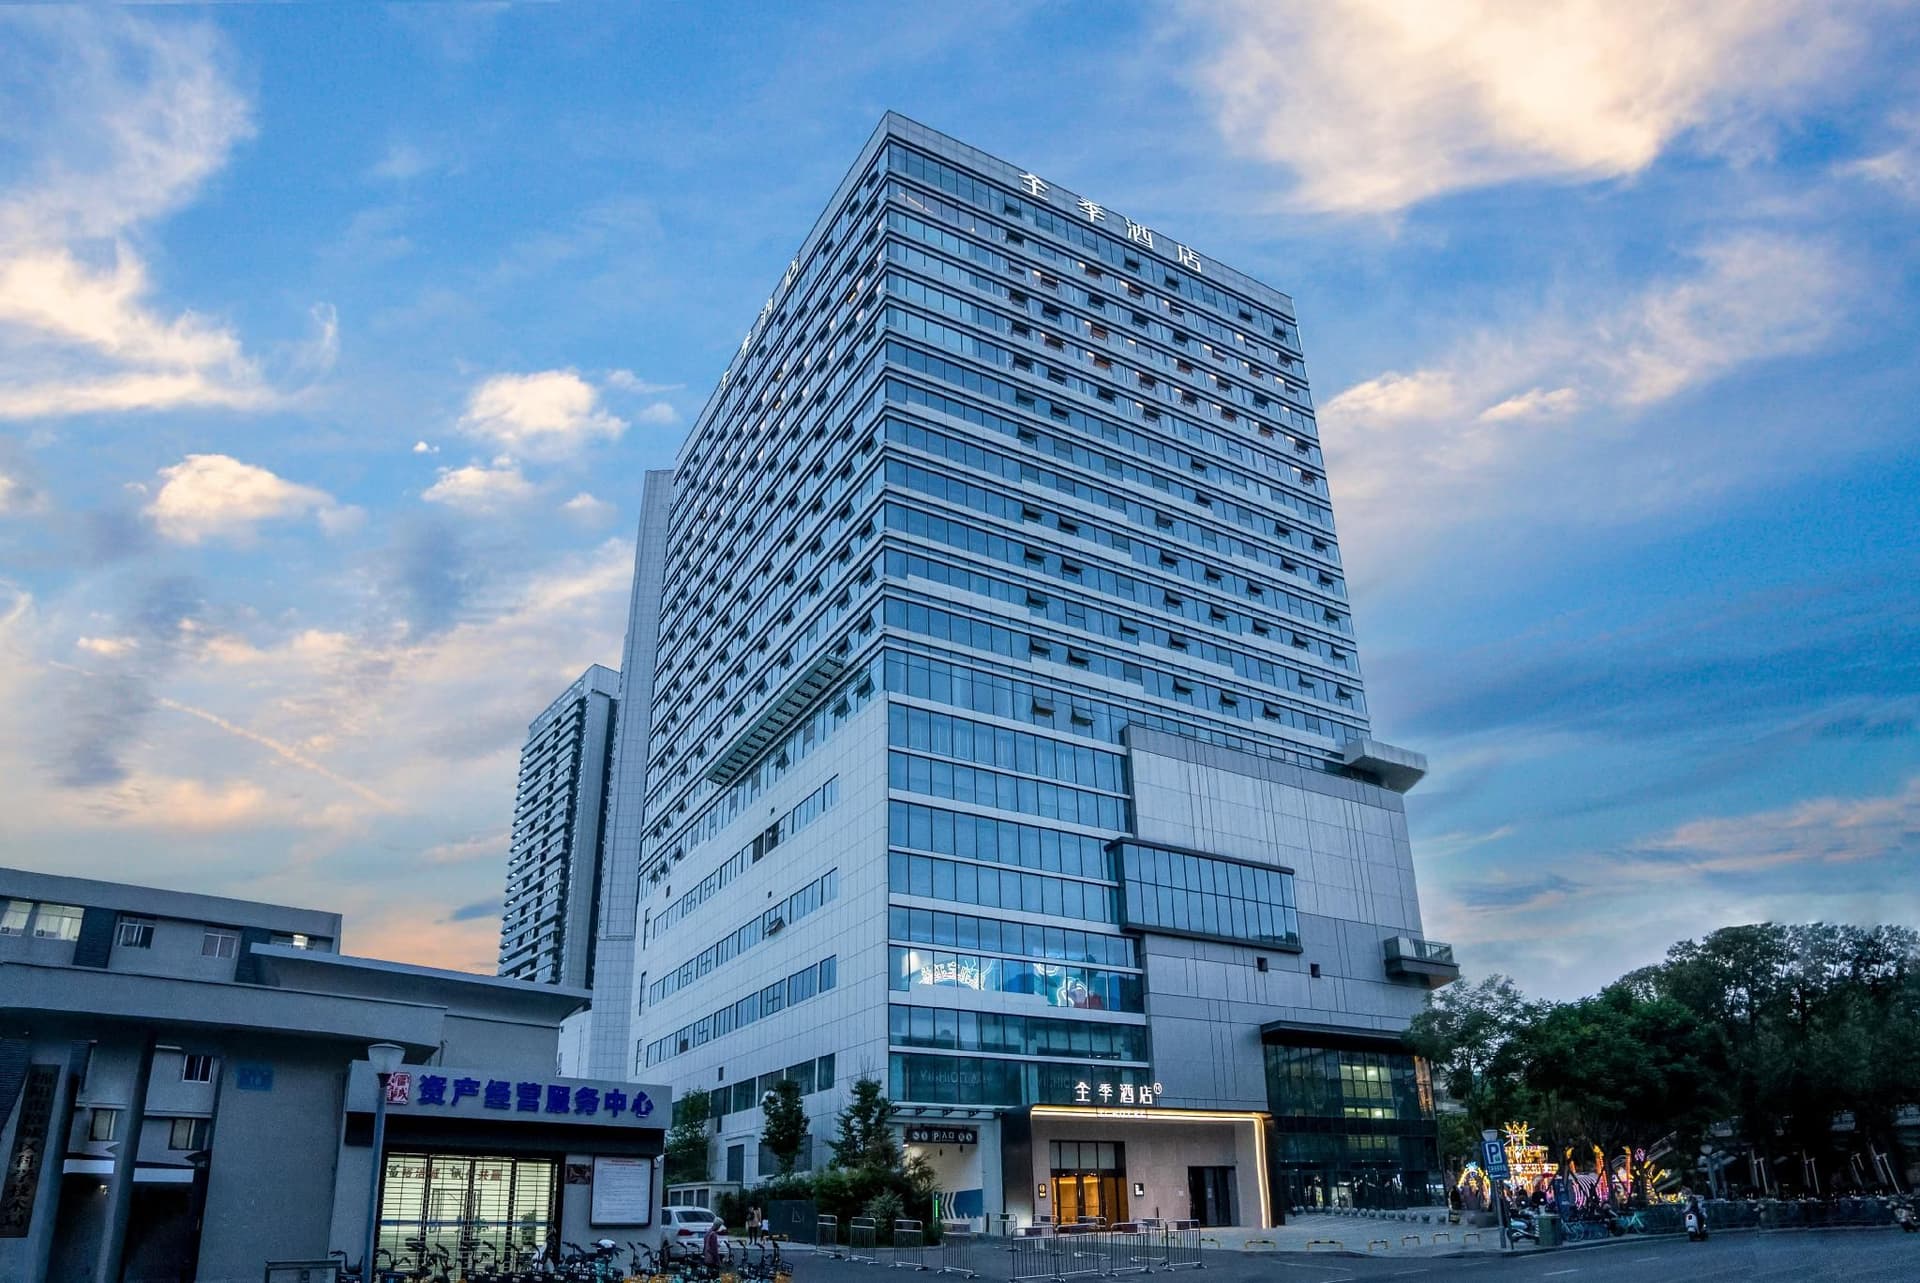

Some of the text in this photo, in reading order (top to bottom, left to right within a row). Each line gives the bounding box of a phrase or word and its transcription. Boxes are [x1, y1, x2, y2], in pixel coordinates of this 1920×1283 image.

[1019, 173, 1202, 273] 全季酒店
[416, 1074, 654, 1118] 资产经营服务中心
[1074, 1081, 1153, 1104] 全季酒店
[1487, 1144, 1499, 1163] P
